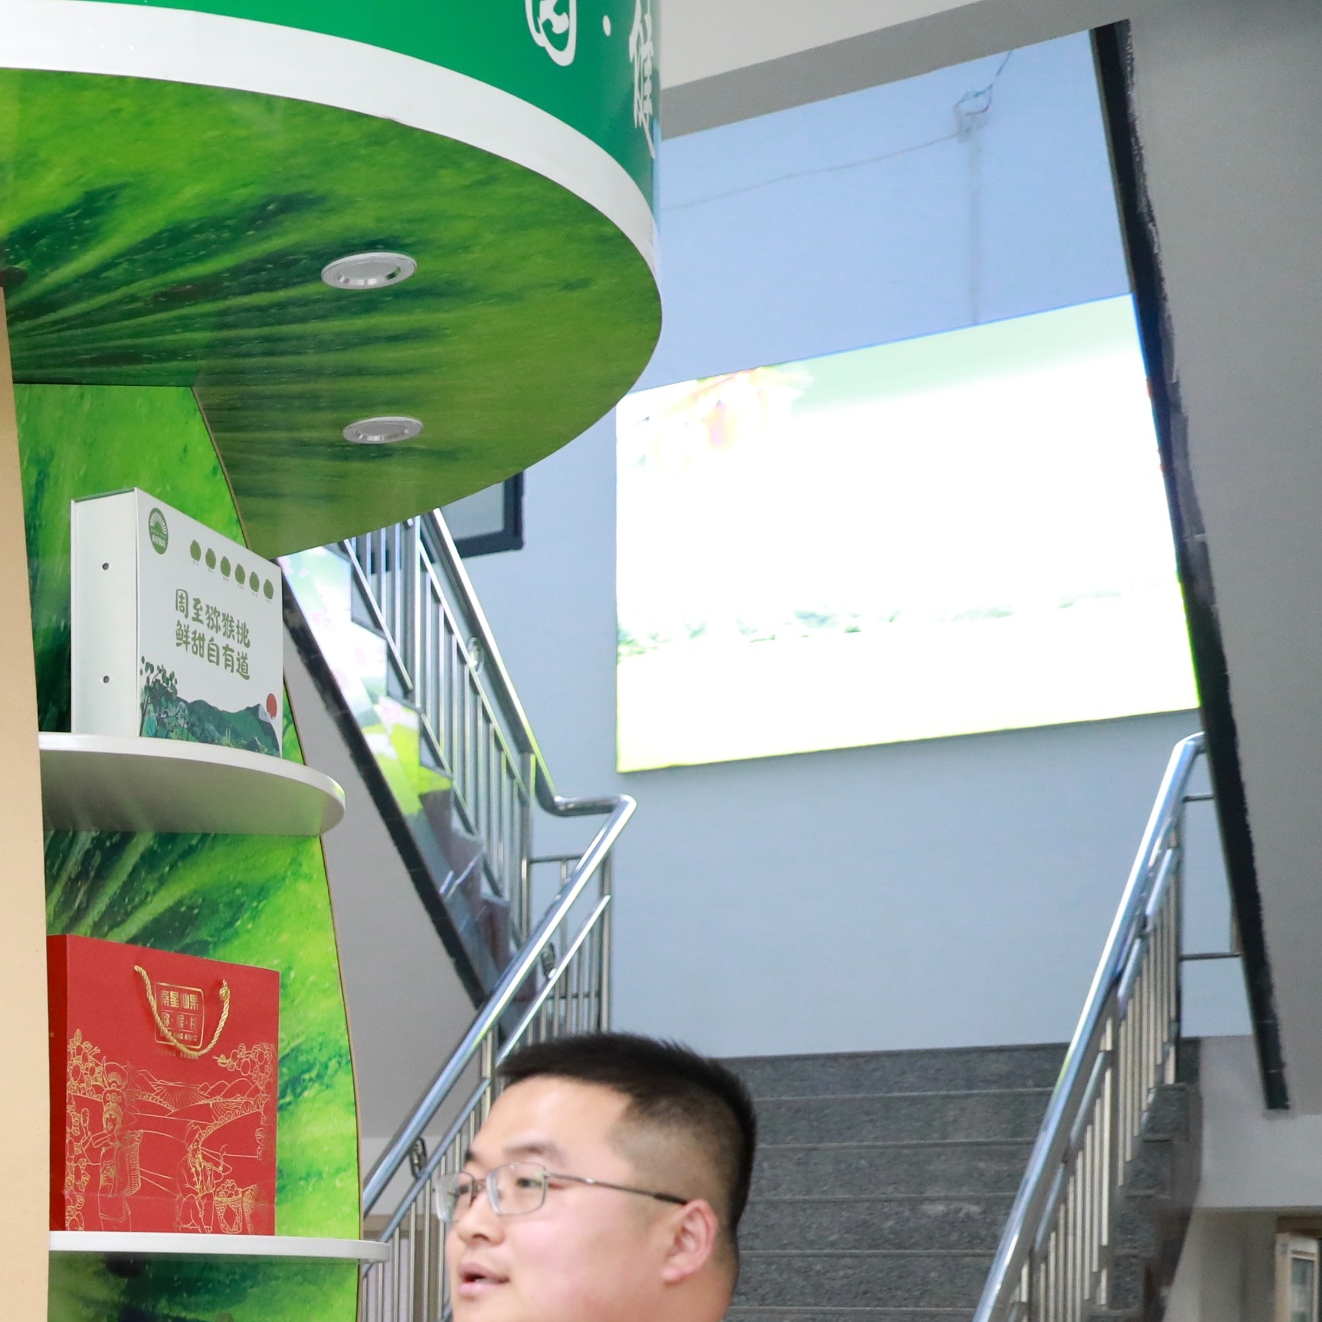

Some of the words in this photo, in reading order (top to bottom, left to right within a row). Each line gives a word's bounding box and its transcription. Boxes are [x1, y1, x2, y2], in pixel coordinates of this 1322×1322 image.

[175, 588, 251, 649] 周至猕猴桃
[175, 620, 250, 681] 鲜甜自有道
